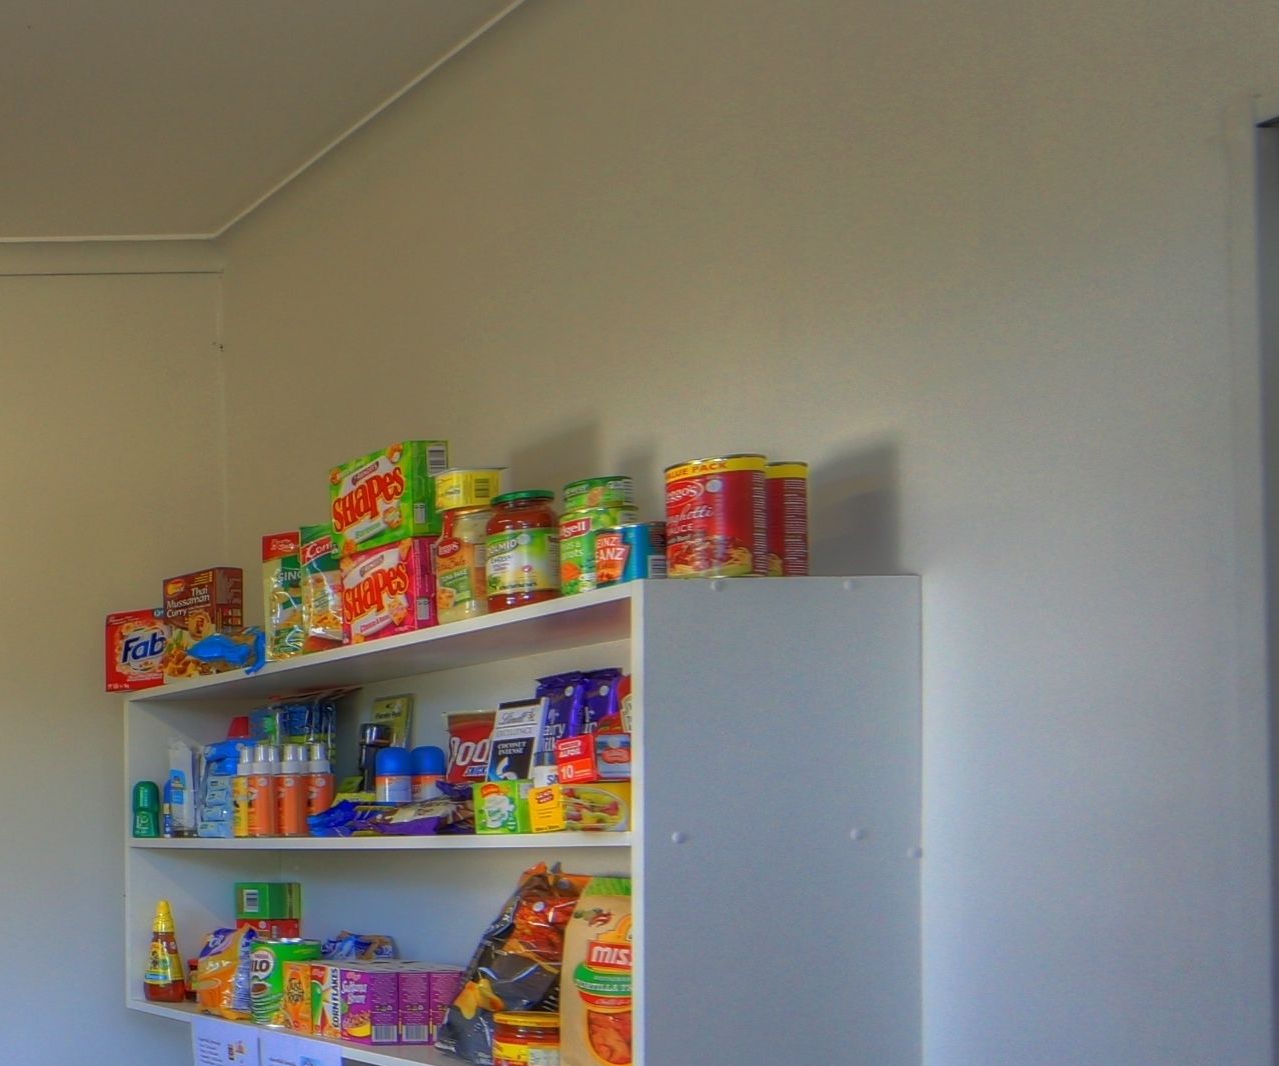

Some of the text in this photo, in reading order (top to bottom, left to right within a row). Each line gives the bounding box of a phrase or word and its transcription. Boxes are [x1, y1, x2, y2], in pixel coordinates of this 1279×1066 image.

[693, 462, 728, 474] PACK
[191, 585, 208, 597] Thai
[167, 594, 210, 609] Mussaman
[167, 608, 188, 618] Curry
[122, 632, 167, 664] Fab
[560, 764, 574, 779] 10
[332, 967, 340, 1027] CORN FLAKES
